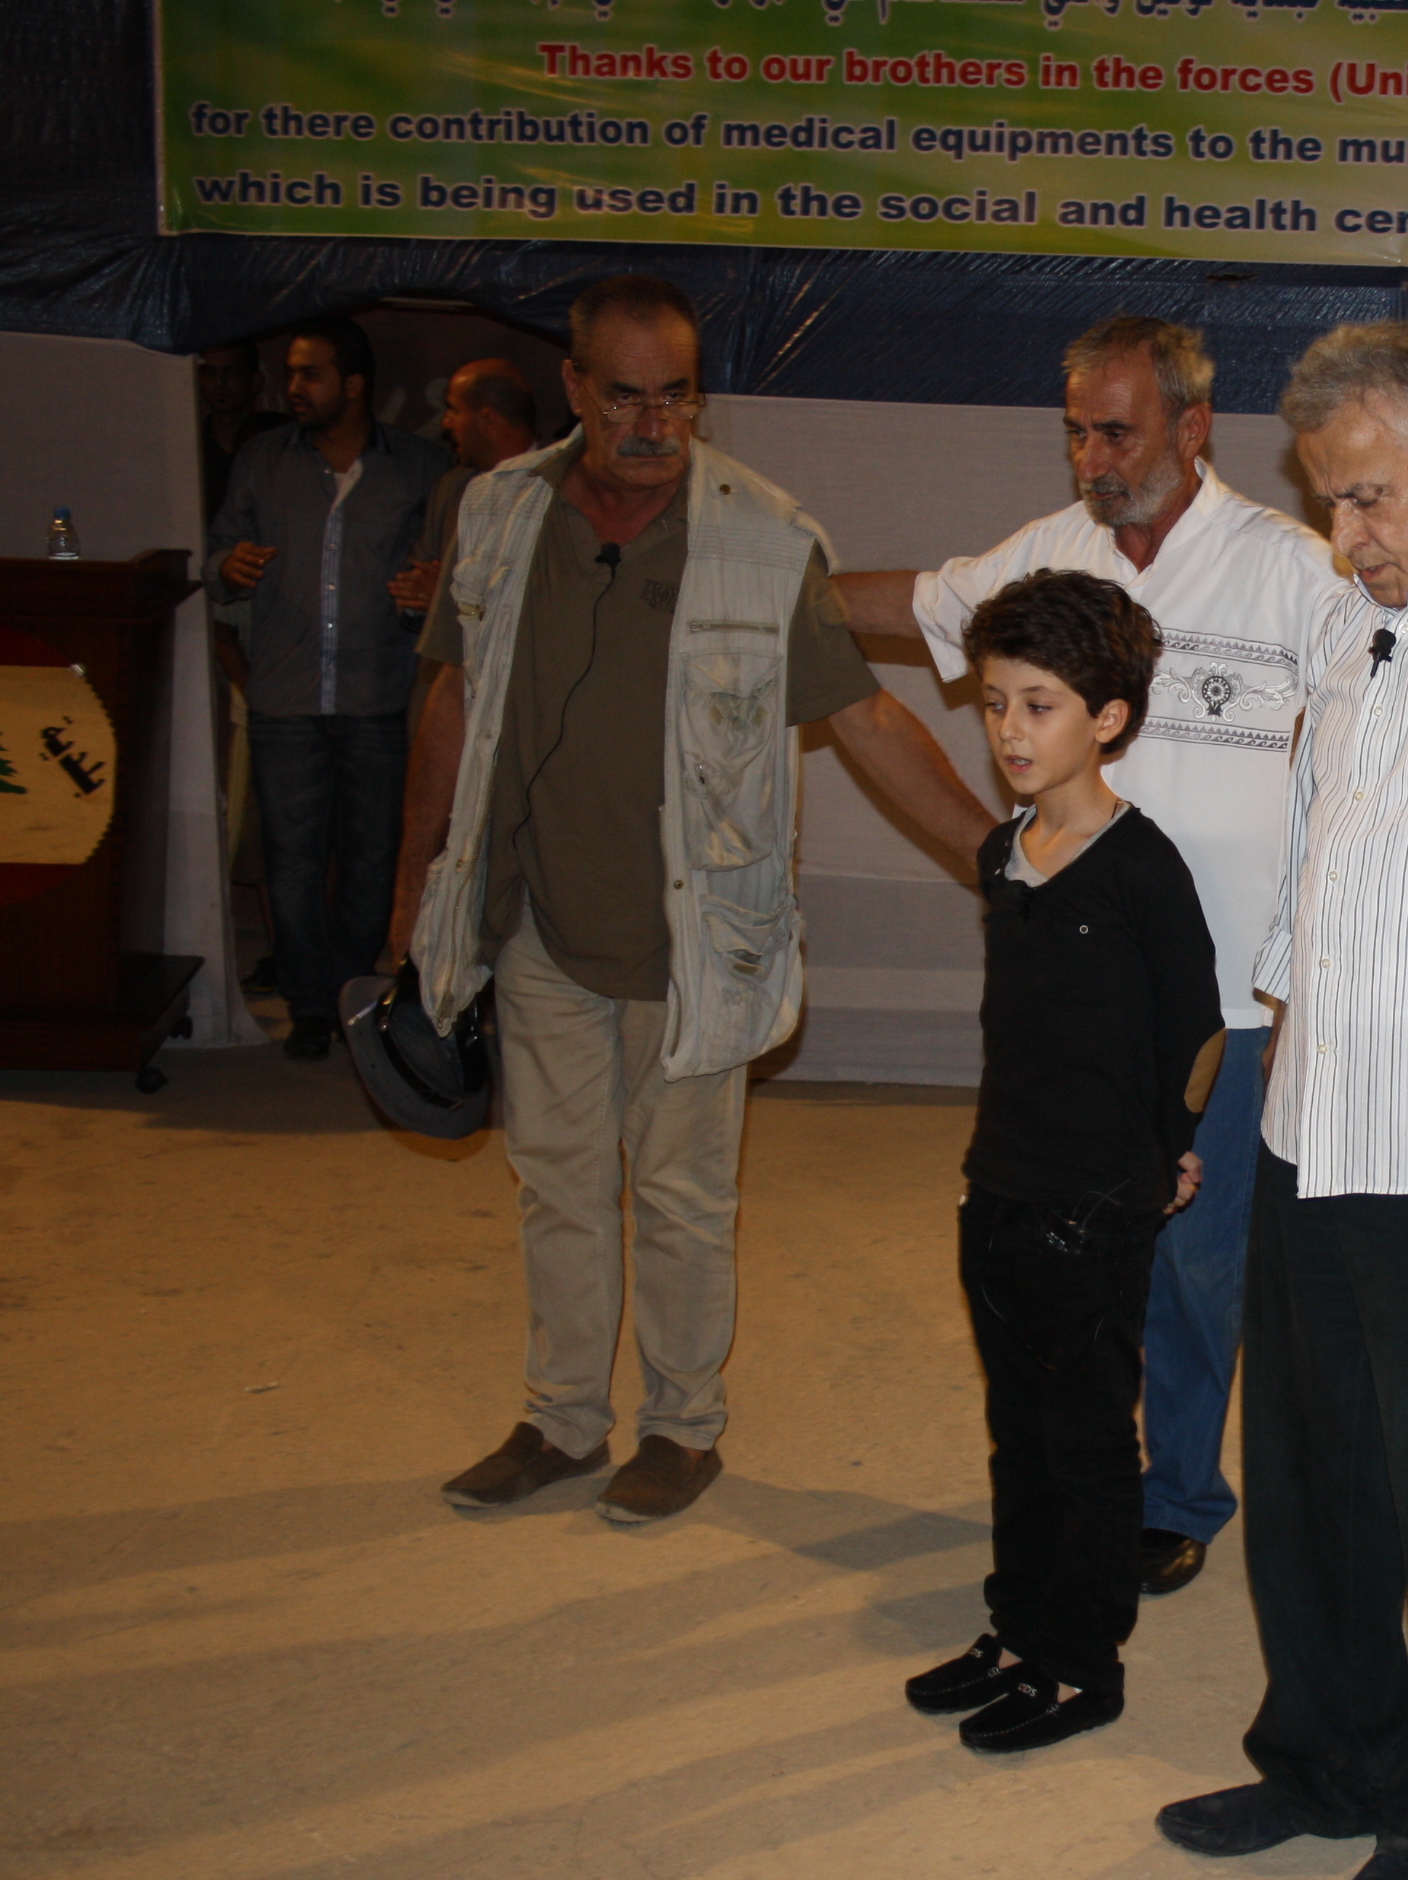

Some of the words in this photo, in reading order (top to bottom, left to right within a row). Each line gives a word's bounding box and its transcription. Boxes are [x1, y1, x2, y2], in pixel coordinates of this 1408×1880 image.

[539, 44, 693, 80] Thanks
[707, 46, 747, 82] to
[762, 53, 833, 84] our
[845, 50, 1026, 88] brothers
[1041, 56, 1079, 89] in
[1093, 57, 1164, 91] the
[1178, 58, 1314, 94] forces
[193, 104, 249, 138] for
[263, 105, 374, 140] there
[390, 109, 648, 146] contribution
[665, 112, 707, 148] of
[723, 117, 895, 151] medical
[912, 120, 1172, 163] equipments
[1190, 129, 1234, 163] to
[1248, 129, 1321, 163] the
[195, 172, 342, 207] which
[361, 173, 400, 206] is
[420, 177, 556, 217] being
[575, 181, 696, 215] used
[713, 181, 759, 216] in
[777, 183, 861, 219] the
[878, 186, 1036, 224] social
[1057, 195, 1147, 229] and
[1164, 197, 1316, 233] health
